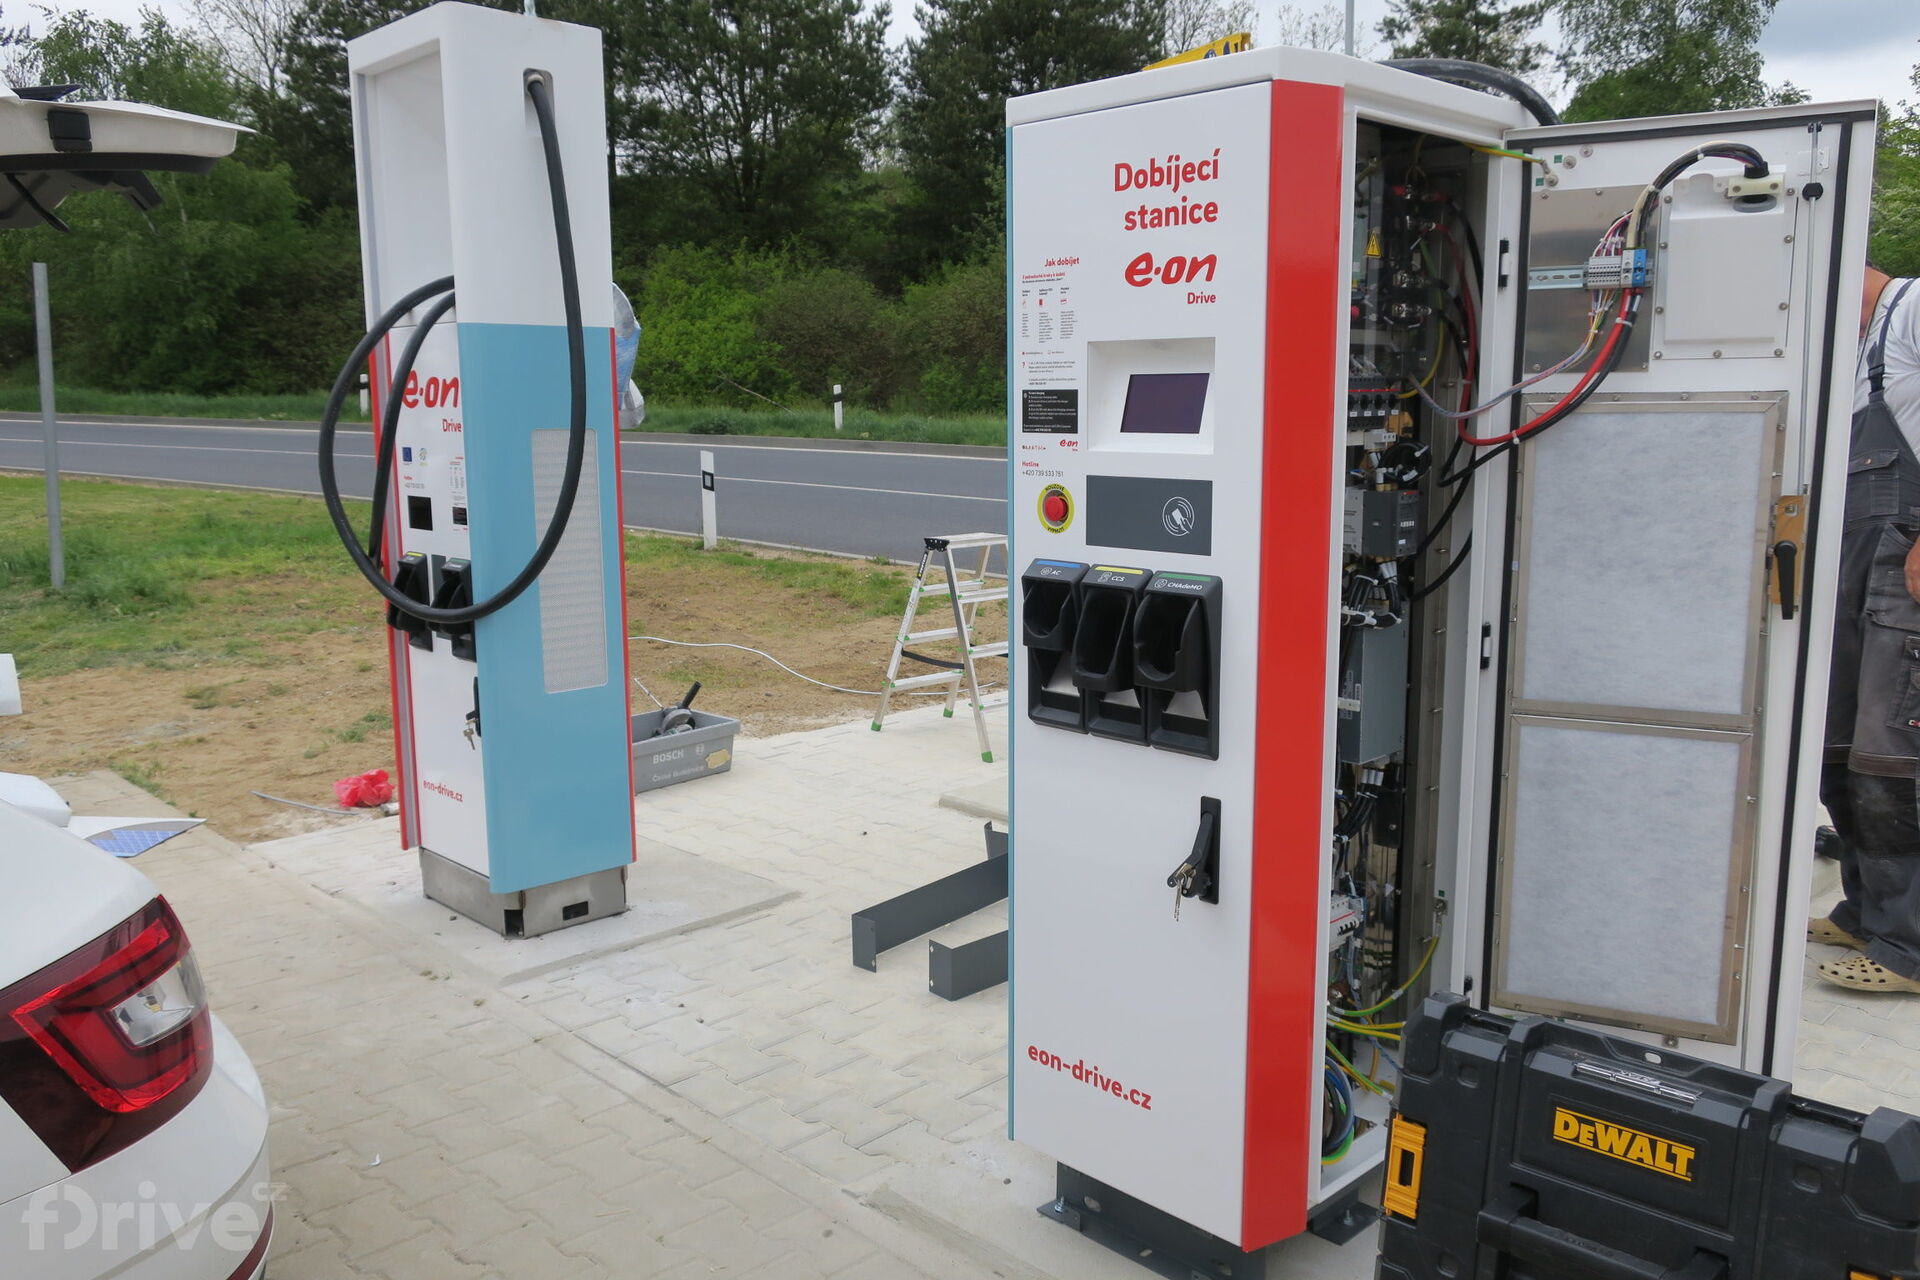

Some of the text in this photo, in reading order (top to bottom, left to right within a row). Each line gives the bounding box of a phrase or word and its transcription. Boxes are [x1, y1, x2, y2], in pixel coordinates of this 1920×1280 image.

[1114, 148, 1220, 193] Dobíjecí
[1124, 195, 1219, 231] stanice
[1044, 257, 1056, 267] Jak
[1186, 291, 1217, 305] Drive
[441, 418, 462, 433] Drive
[1051, 569, 1061, 577] AC
[1111, 574, 1125, 582] CCS
[653, 748, 684, 764] BOSCH
[422, 780, 463, 803] eon-drive.cz
[1027, 1045, 1152, 1111] eon-drive.cz
